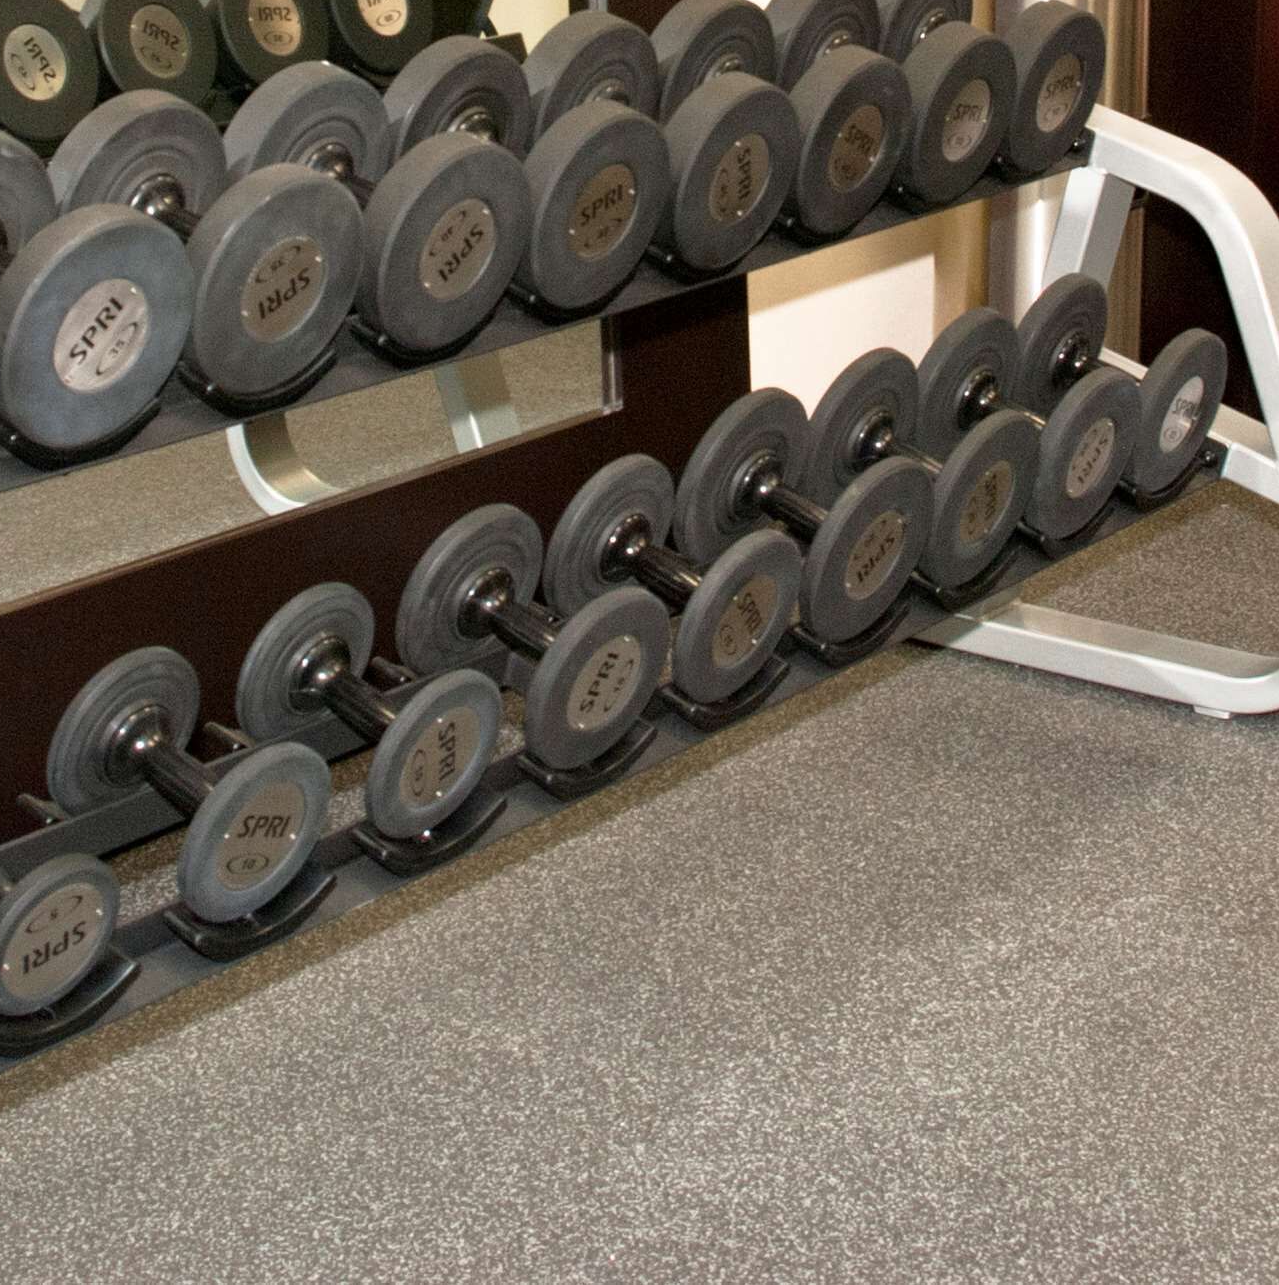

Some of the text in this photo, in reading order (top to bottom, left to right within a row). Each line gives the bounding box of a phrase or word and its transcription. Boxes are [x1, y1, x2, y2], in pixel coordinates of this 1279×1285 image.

[582, 184, 623, 226] SPRI
[438, 223, 484, 282] SPRI
[259, 267, 310, 319] SPRI
[69, 297, 123, 365] SPRI
[580, 653, 619, 713] SPRI
[438, 722, 456, 784] SPRI
[237, 815, 291, 838] SPRI
[23, 920, 86, 974] SPRI
